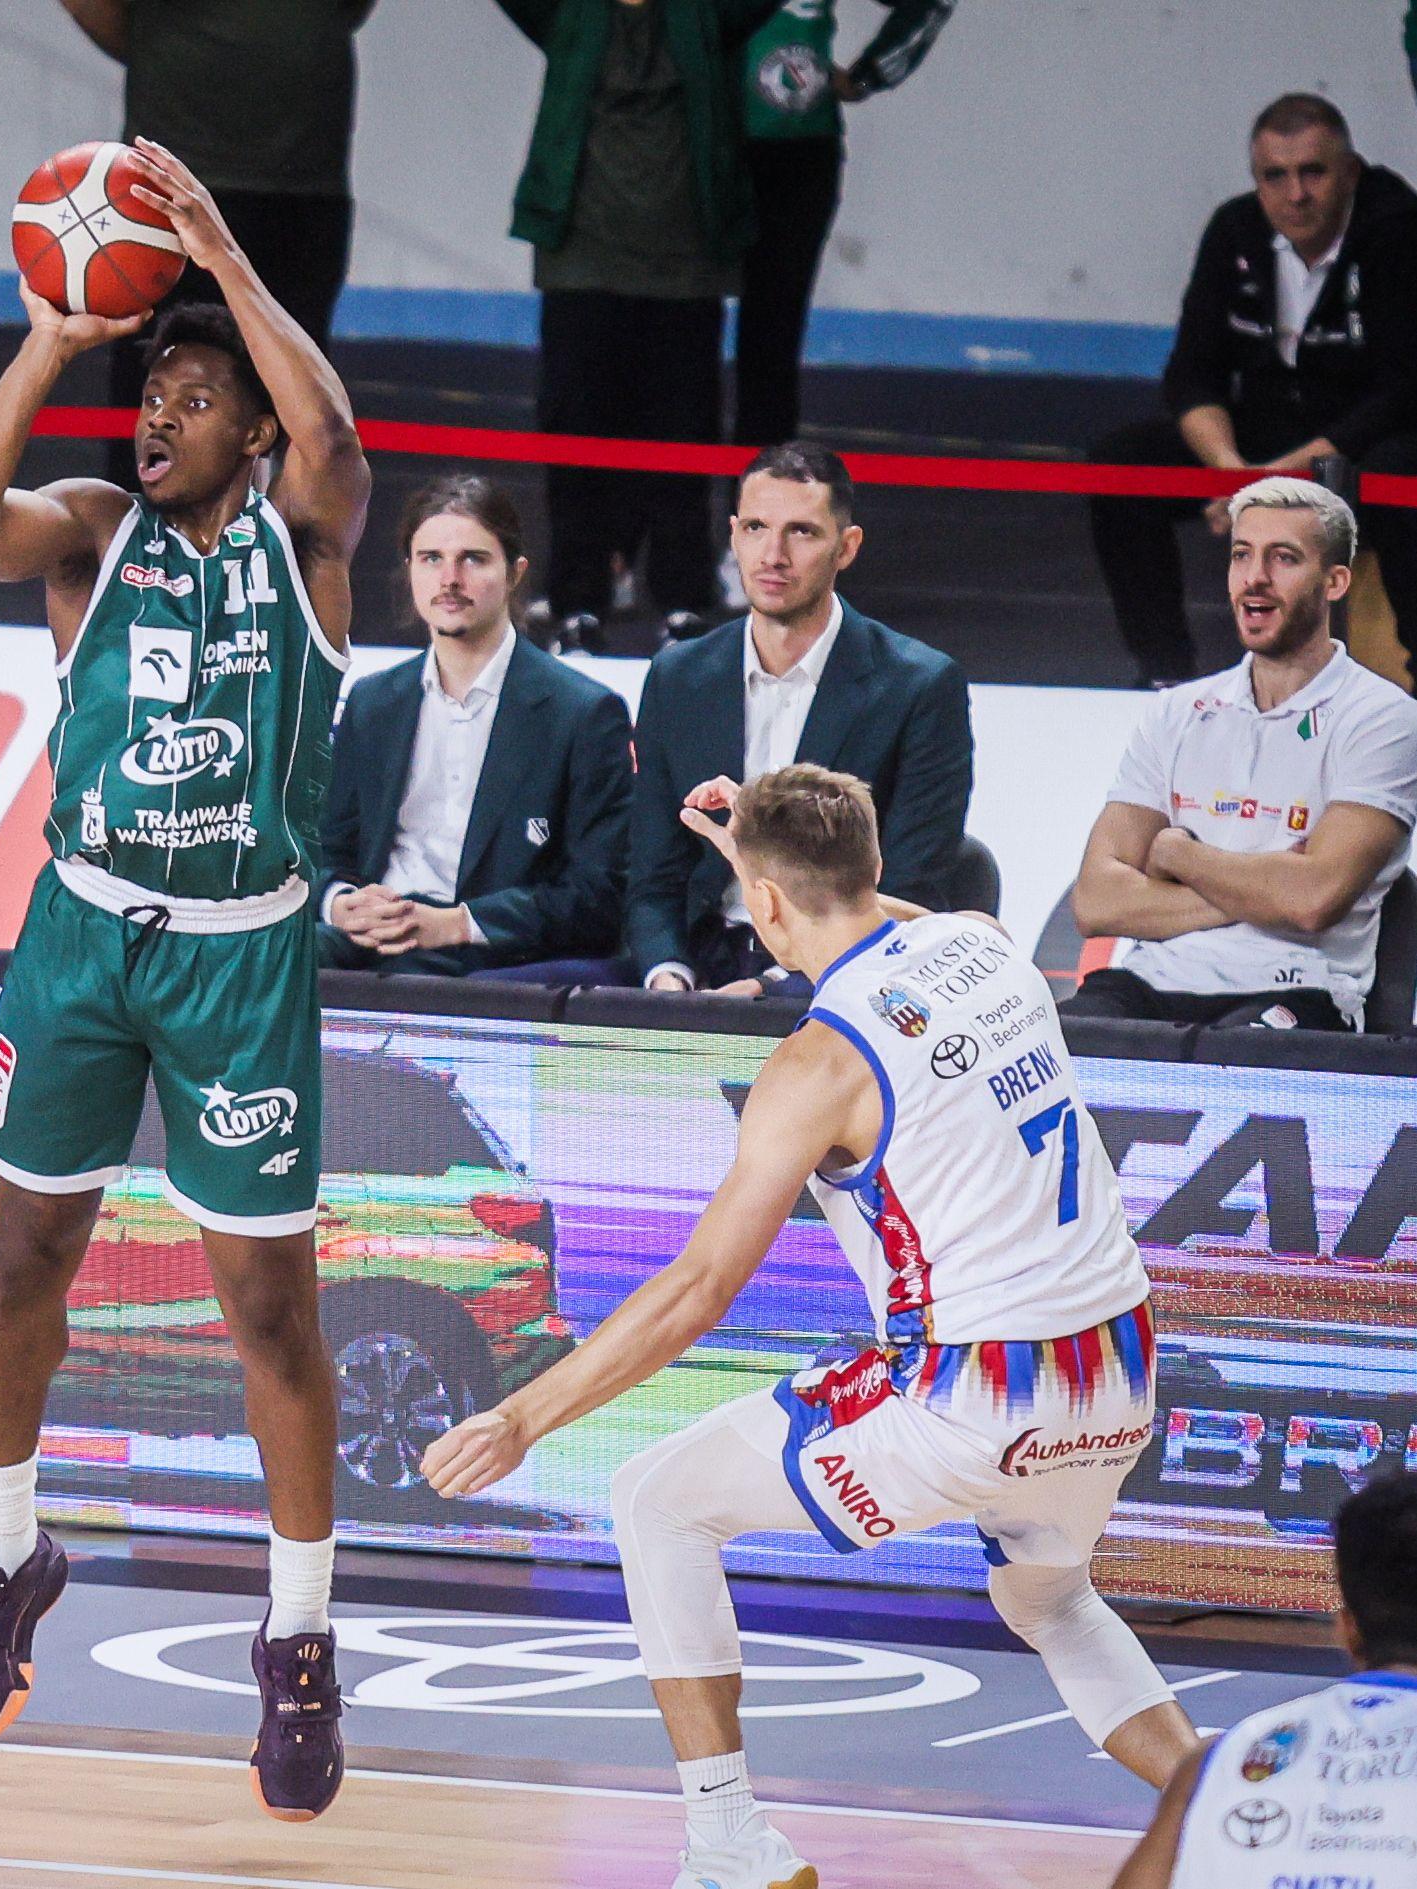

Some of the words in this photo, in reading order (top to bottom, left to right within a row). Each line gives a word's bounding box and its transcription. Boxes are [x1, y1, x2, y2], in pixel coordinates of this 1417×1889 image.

[221, 548, 279, 615] 11
[148, 727, 220, 773] LOTTO
[135, 802, 253, 830] TRAMWAJE
[910, 930, 981, 988] MIASTO
[930, 936, 1011, 1005] TORUŃ
[975, 994, 1024, 1029] Toyota
[990, 1003, 1049, 1049] Bednarscy
[987, 1039, 1062, 1112] BRENK
[215, 1095, 282, 1138] LOTTO
[1017, 1096, 1080, 1228] 7
[815, 1453, 896, 1539] ANIRO
